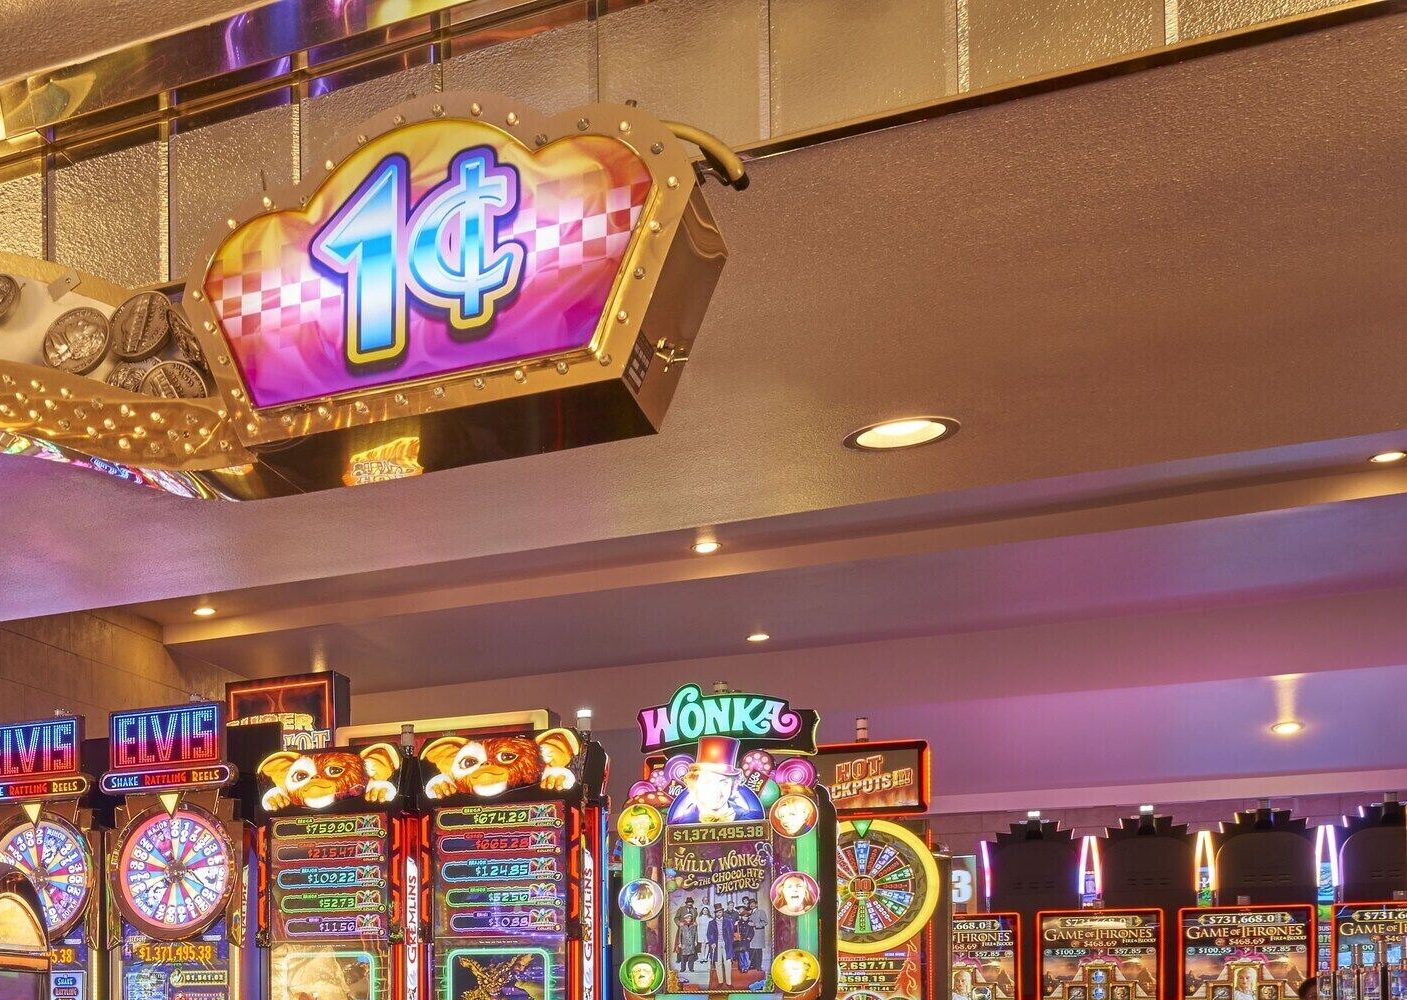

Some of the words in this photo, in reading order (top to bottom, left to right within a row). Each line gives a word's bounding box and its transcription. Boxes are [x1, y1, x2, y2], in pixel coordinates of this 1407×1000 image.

[308, 146, 527, 370] 1¢
[642, 686, 798, 746] WONKA
[118, 709, 214, 764] ELVIS
[836, 754, 883, 784] HOT
[111, 776, 139, 789] SHAKE
[144, 774, 186, 786] RATTLING
[192, 770, 220, 782] REELS
[9, 784, 48, 796] RATTLING
[52, 781, 77, 793] REELS
[473, 811, 527, 824] $674.29
[306, 822, 355, 834] $759.90
[673, 826, 764, 842] $1,371,495.38
[675, 852, 716, 873] WILLY
[719, 849, 766, 871] WONKA
[475, 864, 528, 876] $124.85
[699, 877, 711, 886] THE
[712, 868, 765, 884] CHOCOLATE
[308, 873, 355, 884] $109.22
[716, 878, 761, 893] FACTORY
[319, 899, 354, 908] $52.73
[1044, 928, 1083, 942] GAME
[1096, 928, 1153, 940] THRONES
[1186, 925, 1229, 940] GAME
[1241, 925, 1303, 938] THRONES
[1339, 922, 1384, 936] GAME
[956, 932, 1010, 943] THRONES
[1228, 938, 1265, 946] $468.69
[139, 945, 212, 962] $1,371,495.38
